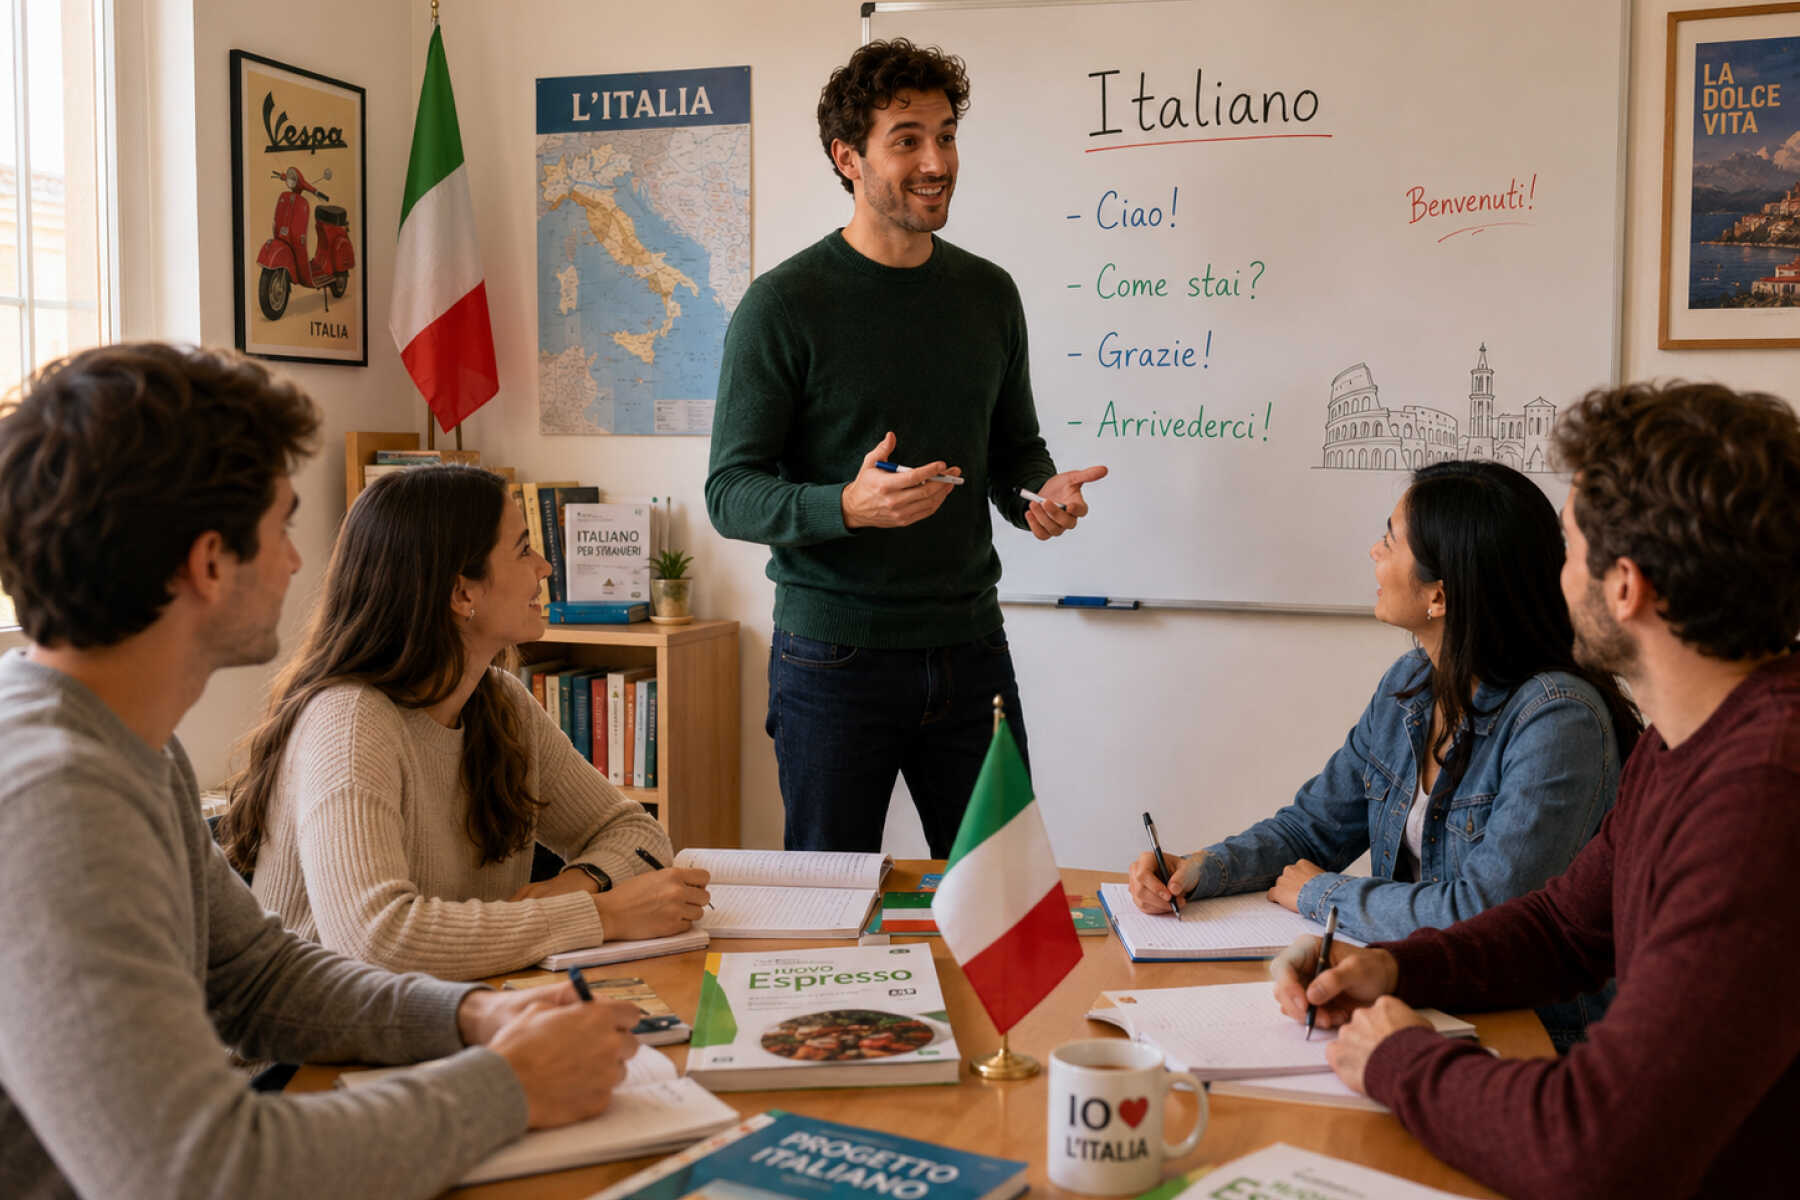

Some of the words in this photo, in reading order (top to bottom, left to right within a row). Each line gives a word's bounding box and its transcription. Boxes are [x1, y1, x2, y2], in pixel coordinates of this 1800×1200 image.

[1704, 62, 1734, 86] LA
[572, 86, 713, 121] L'ITALIA
[1087, 67, 1320, 137] Italiano
[1703, 84, 1781, 111] DOLCE
[262, 91, 347, 155] Vespa
[1703, 111, 1759, 135] VITA
[1096, 186, 1179, 230] Ciao!
[1406, 174, 1537, 224] Benvenuti!
[1096, 263, 1169, 300] Come
[1187, 261, 1266, 300] stai?
[310, 321, 349, 339] ITALIA
[1098, 330, 1213, 370] Grazie!
[1097, 400, 1273, 443] Arrivederci!
[577, 530, 640, 543] ITALIANO
[577, 546, 594, 556] PER
[749, 969, 913, 991] Espresso
[1069, 1094, 1111, 1130] IO
[780, 1131, 960, 1184] PROGETTO
[1066, 1134, 1150, 1162] L'ITALIA
[751, 1147, 929, 1199] ITALIANO
